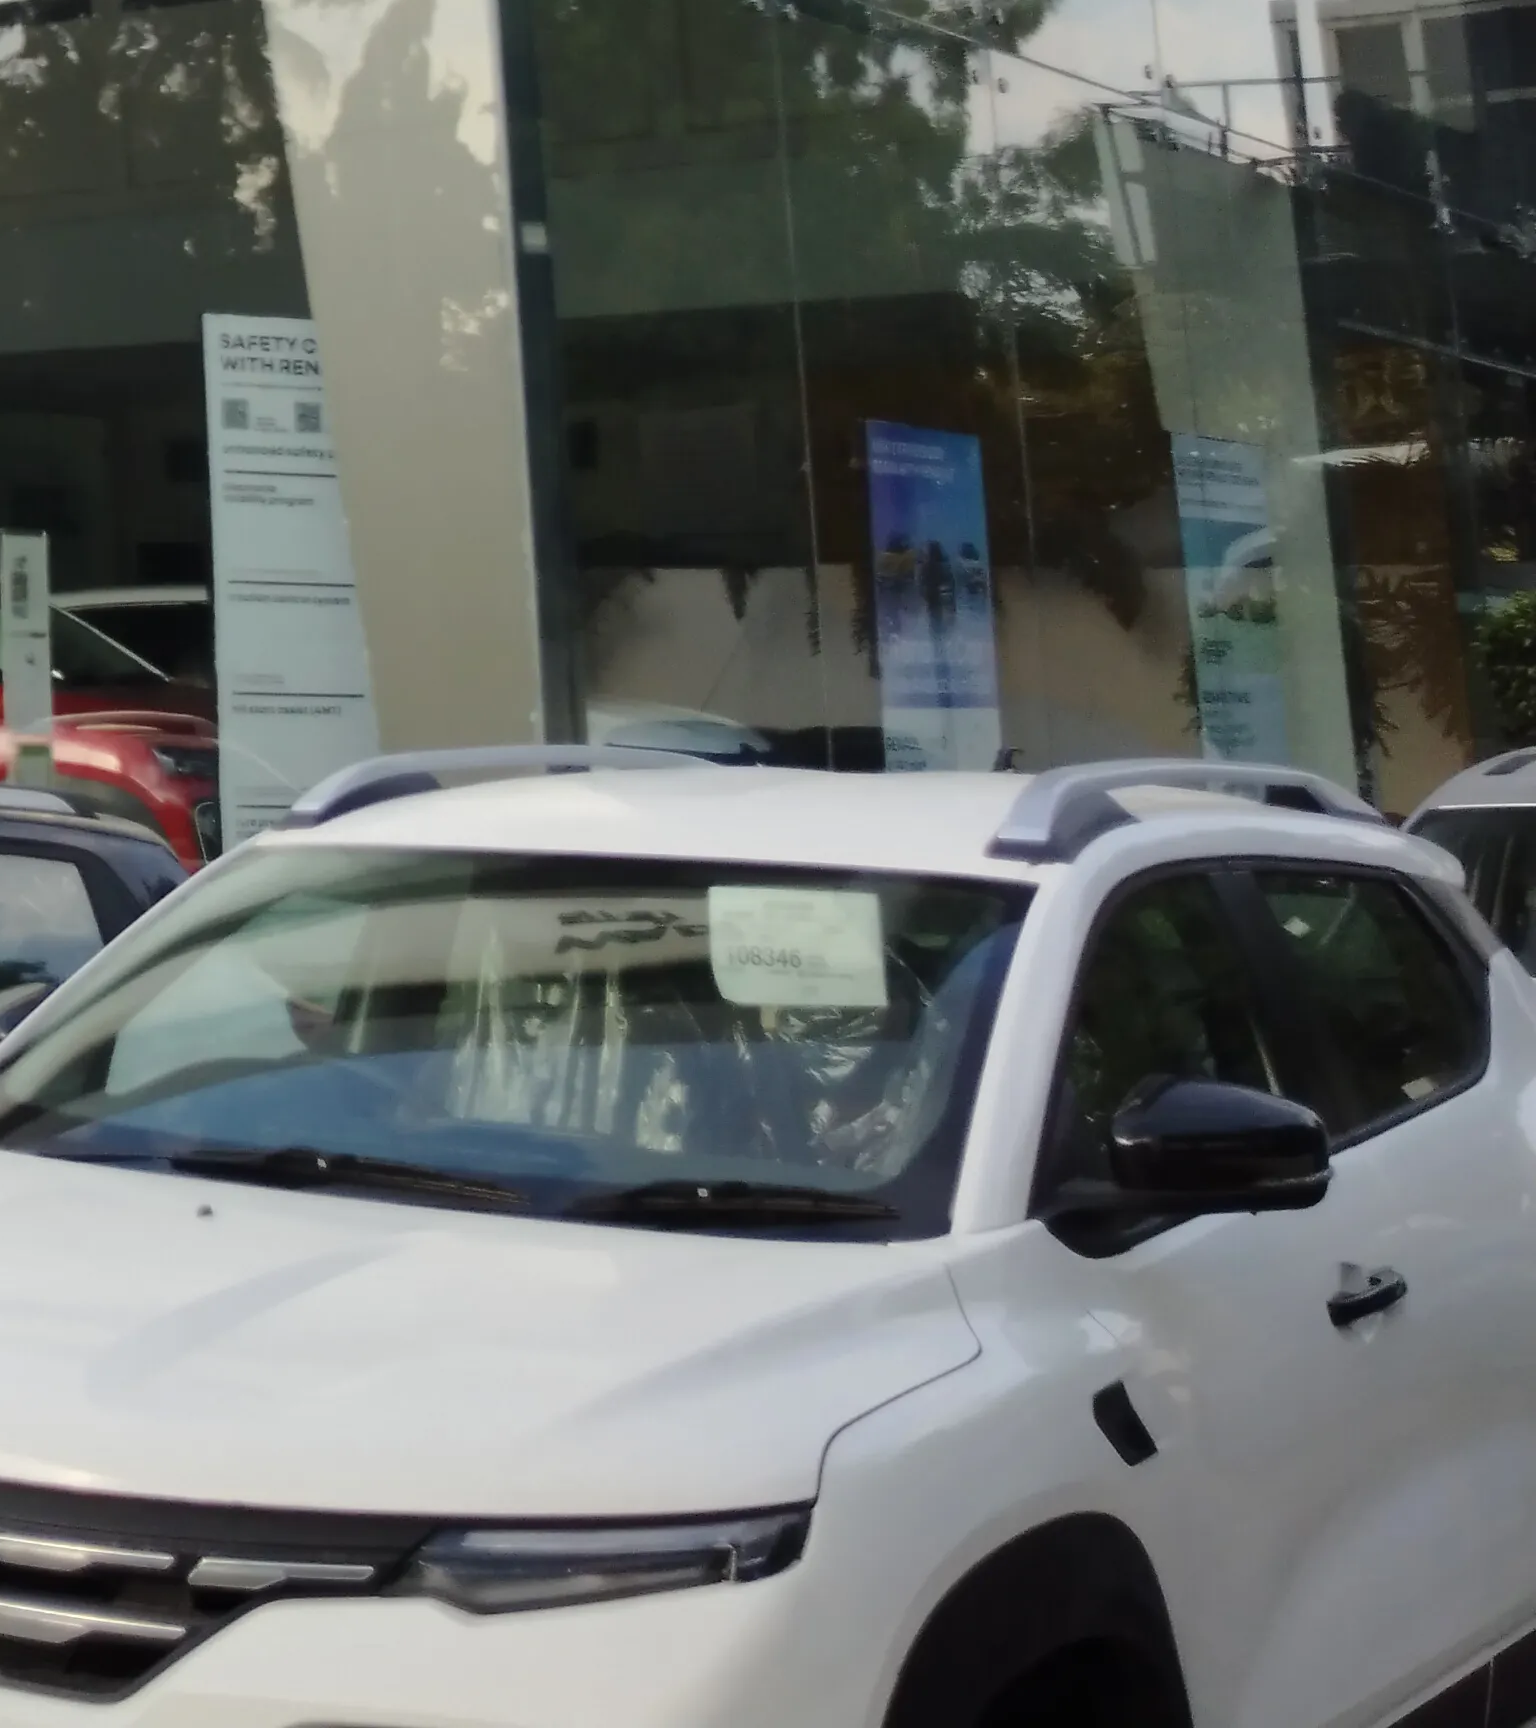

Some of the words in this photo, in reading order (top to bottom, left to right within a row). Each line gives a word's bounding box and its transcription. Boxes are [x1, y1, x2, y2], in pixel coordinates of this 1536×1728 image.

[219, 333, 298, 353] SAFETY
[221, 356, 274, 372] WITH
[279, 359, 321, 376] REN
